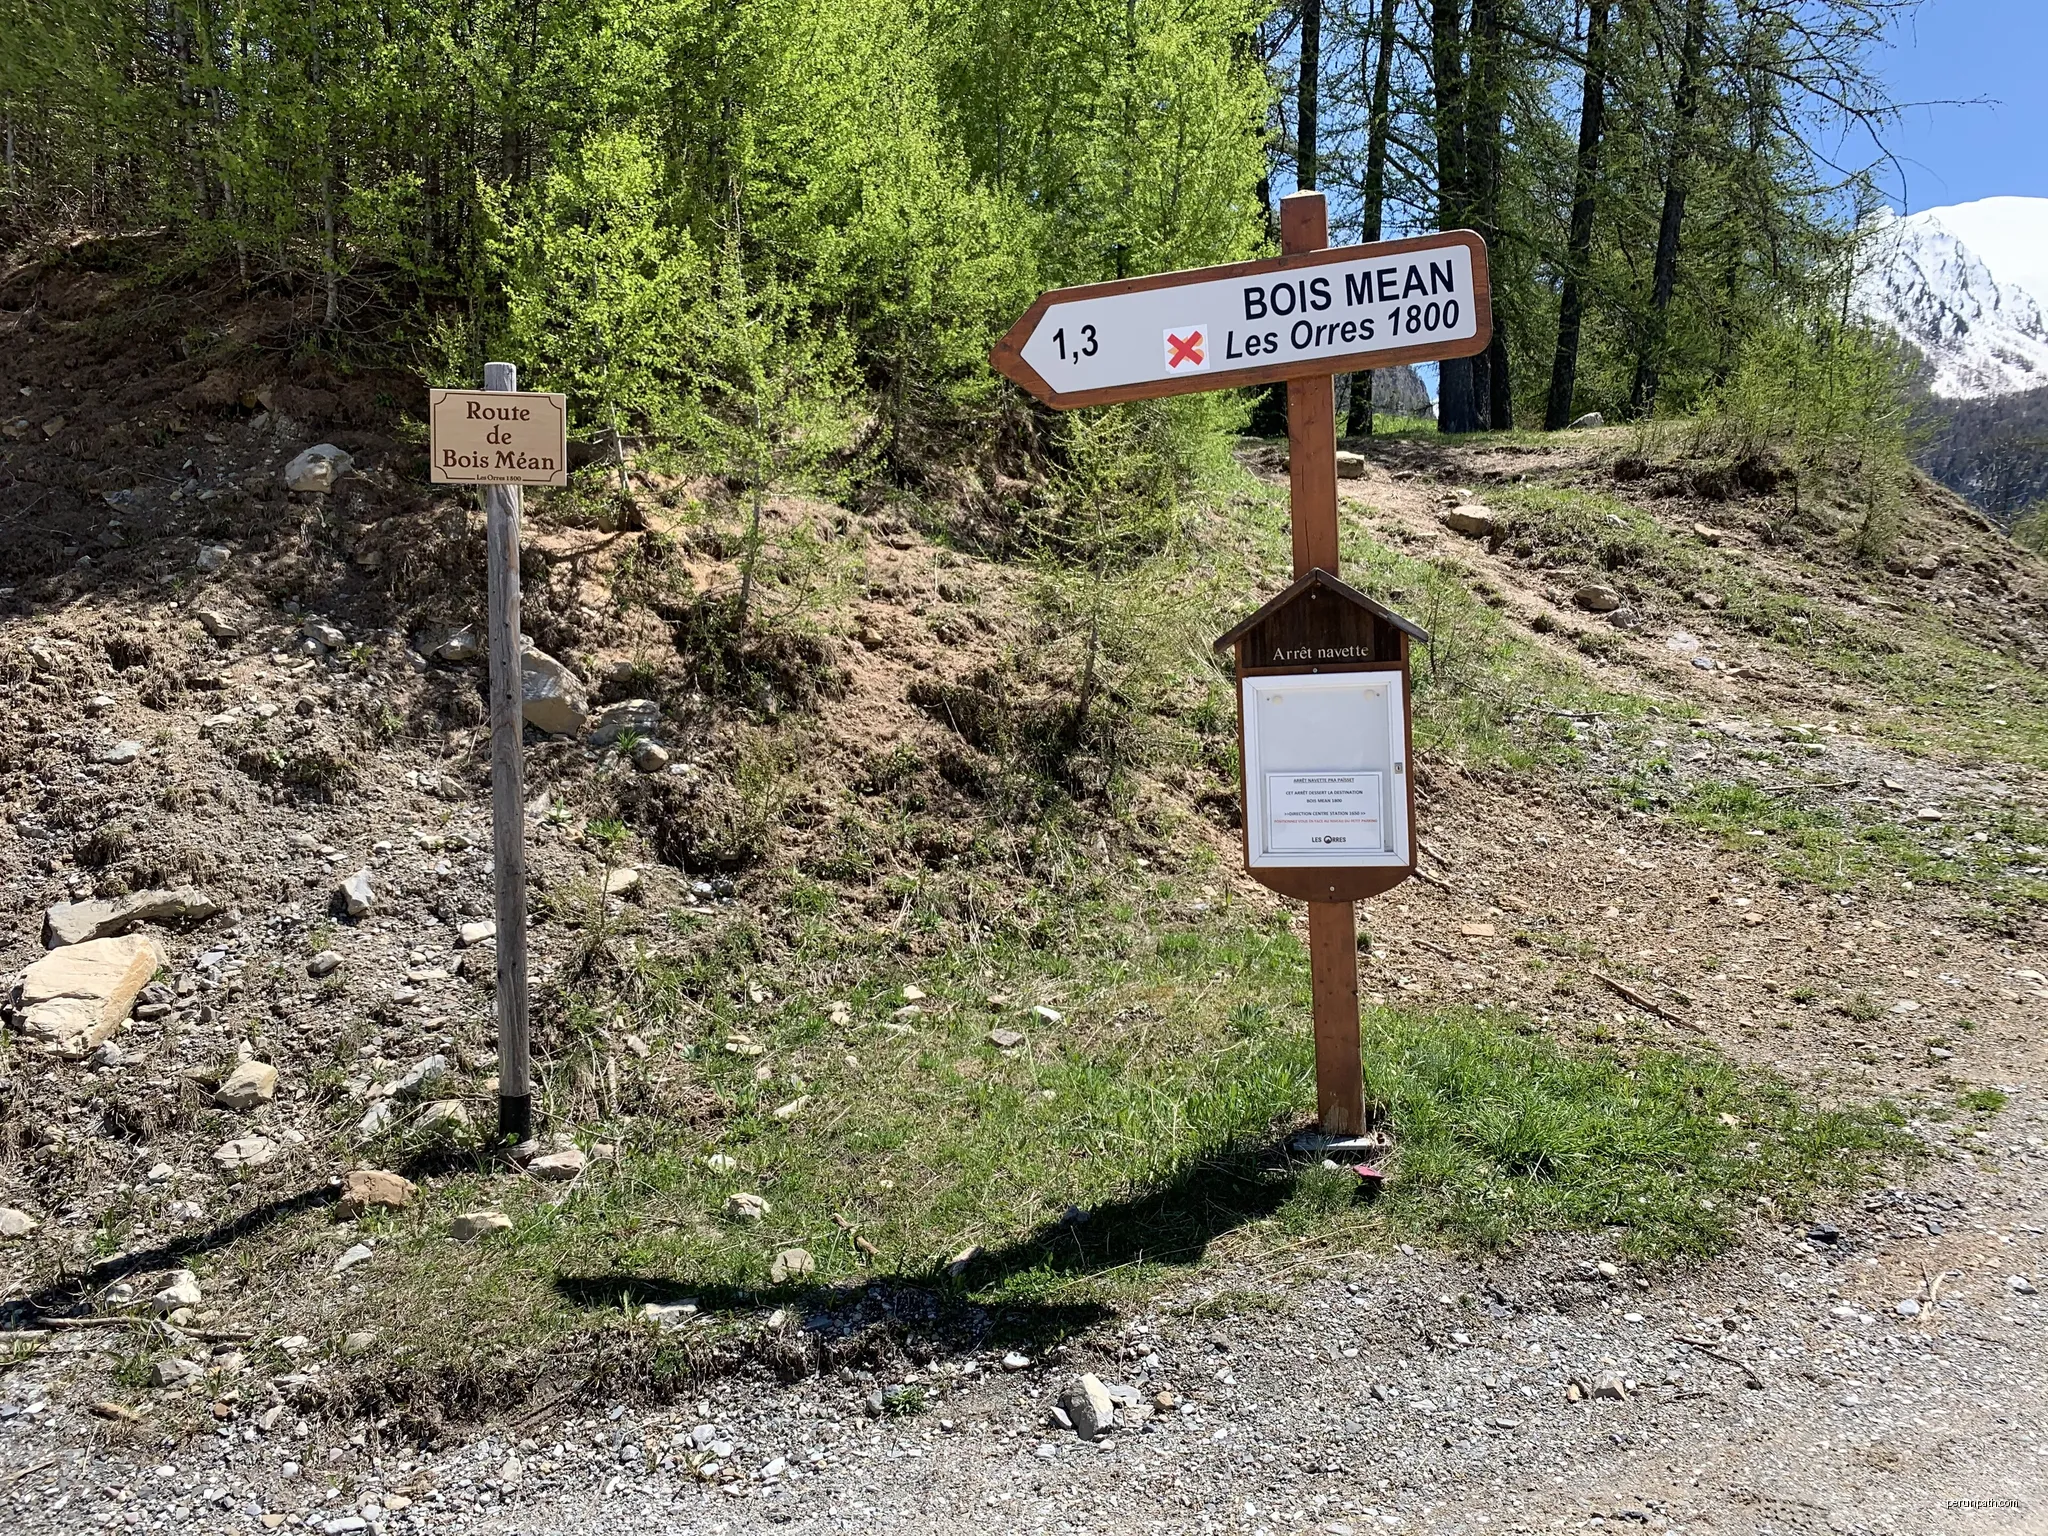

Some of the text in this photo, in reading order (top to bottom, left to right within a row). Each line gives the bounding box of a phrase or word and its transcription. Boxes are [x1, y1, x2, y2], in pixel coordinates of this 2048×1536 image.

[1244, 259, 1455, 320] BOIS MEAN
[1226, 299, 1460, 359] Les Orres 1800
[1052, 324, 1099, 365] 1,3
[466, 401, 531, 421] Route
[486, 424, 512, 445] de
[443, 449, 555, 470] Bois Méan
[1273, 645, 1369, 660] Arrêt navette
